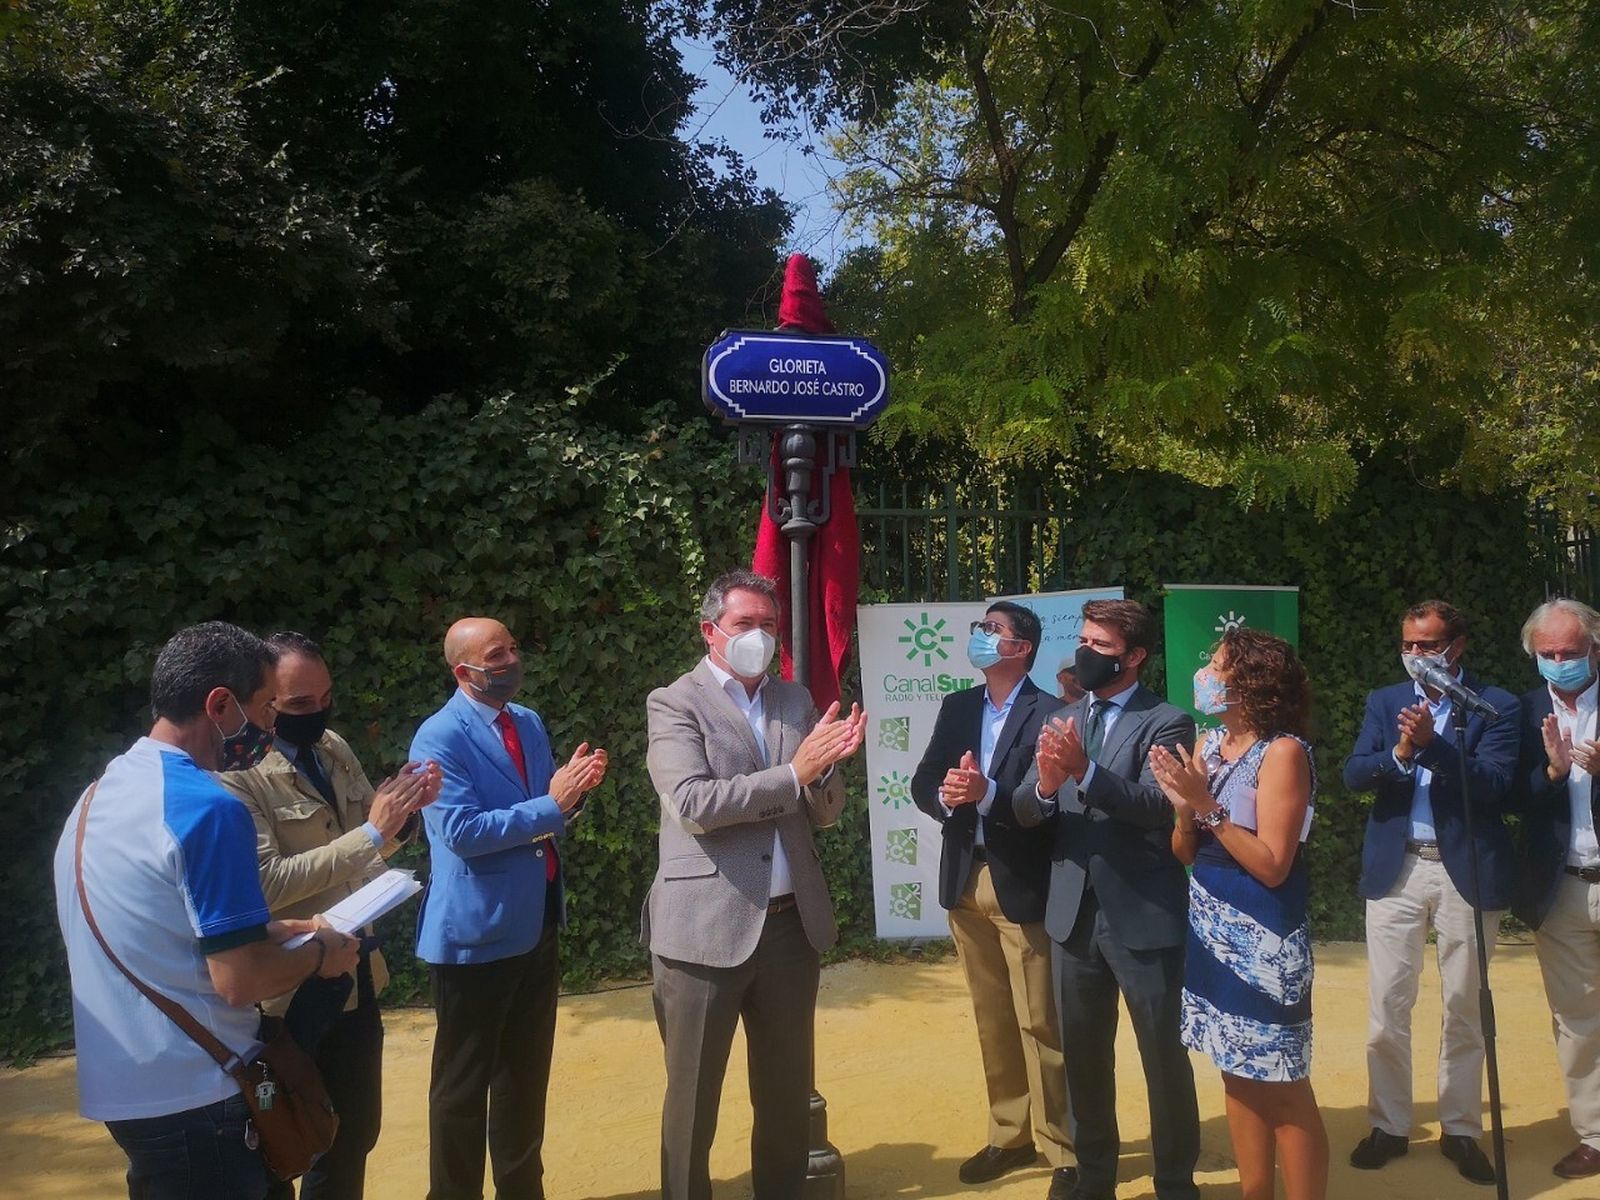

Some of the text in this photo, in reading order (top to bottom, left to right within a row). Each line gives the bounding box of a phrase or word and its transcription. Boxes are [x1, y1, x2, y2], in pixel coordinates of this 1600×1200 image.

[769, 358, 827, 375] GLORIETA
[729, 378, 865, 397] BERNARDO JOSÉ CASTRO
[885, 693, 914, 702] RADIO
[916, 693, 922, 702] Y
[911, 883, 920, 895] 2
